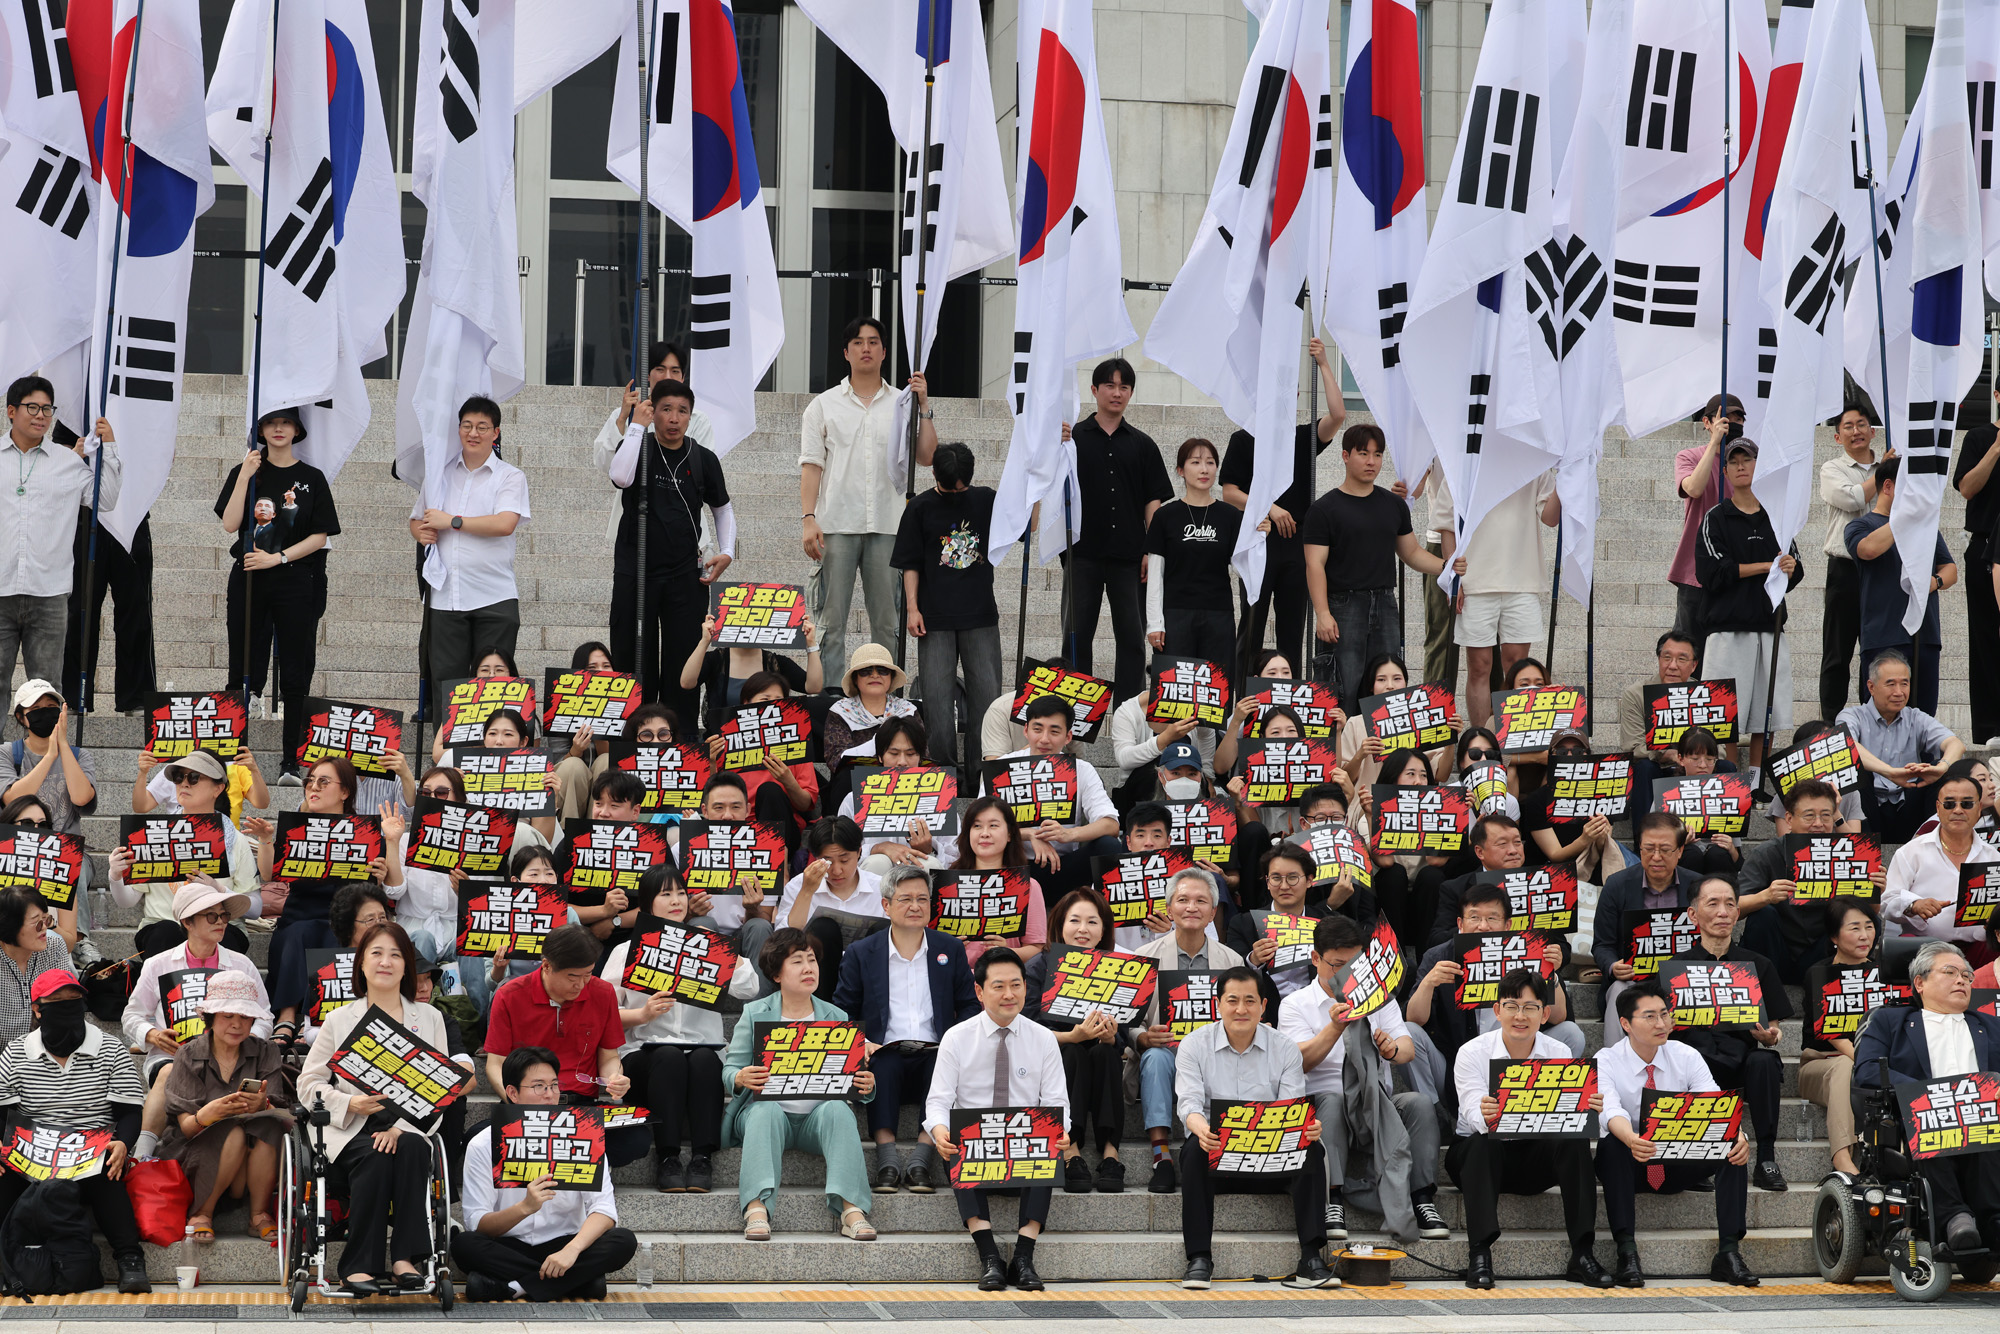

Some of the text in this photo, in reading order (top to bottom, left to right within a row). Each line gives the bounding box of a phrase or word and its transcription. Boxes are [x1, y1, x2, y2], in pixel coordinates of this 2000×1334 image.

[721, 586, 797, 608] 한 표의
[717, 626, 797, 645] 돌려달라
[1175, 662, 1211, 685] 꼼수
[451, 683, 529, 704] 한 표의
[553, 674, 635, 696] 한 표의
[1027, 667, 1106, 703] 한 표의
[1163, 682, 1220, 704] 개헌 말고
[1271, 683, 1312, 706] 꼼수
[170, 697, 216, 719] 꼼수
[1385, 689, 1428, 717] 꼼수
[1502, 692, 1577, 714] 한 표의
[1668, 686, 1709, 708] 꼼수
[329, 706, 374, 732] 꼼수
[737, 705, 782, 731] 꼼수
[1197, 704, 1224, 723] 특검
[1376, 708, 1444, 736] 개헌 말고
[1655, 705, 1725, 725] 개헌 말고
[156, 719, 231, 738] 개헌 말고
[313, 726, 347, 748] 개헌
[726, 724, 798, 750] 개헌 말고
[1419, 726, 1449, 743] 특검
[637, 748, 682, 770] 꼼수
[725, 748, 764, 769] 진짜
[1177, 746, 1191, 757] D
[1264, 743, 1308, 764] 꼼수
[461, 756, 500, 772] 국민
[1008, 760, 1052, 785] 꼼수
[1250, 765, 1322, 782] 개헌 말고
[1553, 763, 1592, 779] 국민
[662, 771, 696, 788] 말고
[863, 772, 945, 794] 한 표의
[1679, 779, 1723, 800] 꼼수
[1034, 781, 1065, 801] 말고
[1247, 785, 1286, 801] 진짜
[1398, 790, 1442, 812] 꼼수
[868, 794, 939, 814] 권리를
[1039, 802, 1071, 819] 특검
[1704, 798, 1738, 814] 말고
[306, 818, 353, 841] 꼼수
[441, 806, 488, 832] 꼼수
[1385, 813, 1455, 831] 개헌 말고
[1708, 817, 1744, 832] 특검
[146, 820, 194, 841] 꼼수
[423, 826, 499, 852] 개헌 말고
[592, 825, 638, 849] 꼼수
[707, 826, 755, 849] 꼼수
[1187, 826, 1222, 844] 말고
[1310, 828, 1354, 850] 꼼수
[1379, 833, 1462, 850] 진짜 특검
[15, 831, 61, 858] 꼼수
[133, 842, 212, 860] 개헌 말고
[290, 841, 367, 861] 개헌 말고
[1811, 838, 1854, 861] 꼼수
[281, 860, 325, 877] 진짜
[413, 846, 503, 870] 진짜 특검
[577, 848, 611, 868] 개헌
[692, 849, 770, 868] 개헌 말고
[1119, 855, 1166, 881] 꼼수
[1338, 846, 1366, 870] 말고
[40, 860, 70, 882] 말고
[132, 862, 174, 878] 진짜
[572, 869, 615, 887] 진짜
[686, 870, 730, 887] 진짜
[1798, 862, 1867, 879] 개헌 말고
[957, 875, 1004, 897] 꼼수
[1106, 882, 1143, 900] 개헌
[1505, 871, 1550, 896] 꼼수
[1794, 882, 1832, 898] 진짜
[489, 887, 537, 912] 꼼수
[943, 896, 1016, 916] 개헌 말고
[1531, 892, 1564, 911] 말고
[472, 911, 552, 933] 개헌 말고
[985, 916, 1022, 934] 특검
[1267, 914, 1290, 928] 한
[1534, 911, 1571, 929] 특검
[660, 925, 709, 957] 꼼수
[1480, 936, 1525, 961] 꼼수
[1636, 937, 1670, 954] 개헌
[641, 945, 719, 982] 개헌 말고
[1057, 952, 1149, 984] 한 표의
[1467, 962, 1500, 981] 개헌
[630, 966, 721, 1003] 진짜 특검
[1686, 966, 1732, 987] 꼼수
[1057, 975, 1137, 1006] 권리를
[1675, 987, 1751, 1006] 개헌 말고
[1172, 1001, 1209, 1019] 개헌
[1826, 994, 1863, 1012] 개헌
[1720, 1006, 1759, 1023] 특검
[765, 1028, 857, 1050] 한 표의
[365, 1019, 461, 1088] 국민 검열
[770, 1052, 848, 1074] 권리를
[350, 1036, 448, 1103] 입틀막법
[1499, 1065, 1589, 1087] 한 표의
[1502, 1090, 1580, 1112] 권리를
[1927, 1079, 1978, 1108] 꼼수
[1222, 1103, 1308, 1128] 한 표의
[1649, 1096, 1738, 1118] 한 표의
[1916, 1102, 1997, 1129] 개헌 말고
[523, 1111, 575, 1137] 꼼수
[980, 1113, 1031, 1137] 꼼수
[1495, 1113, 1587, 1132] 돌려달라
[1652, 1120, 1728, 1140] 권리를
[506, 1138, 590, 1160] 개헌 말고
[965, 1139, 1048, 1159] 개헌 말고
[1224, 1130, 1302, 1152] 권리를
[1919, 1130, 1962, 1150] 진짜
[960, 1160, 1057, 1181] 진짜 특검
[1216, 1150, 1307, 1172] 돌려달라
